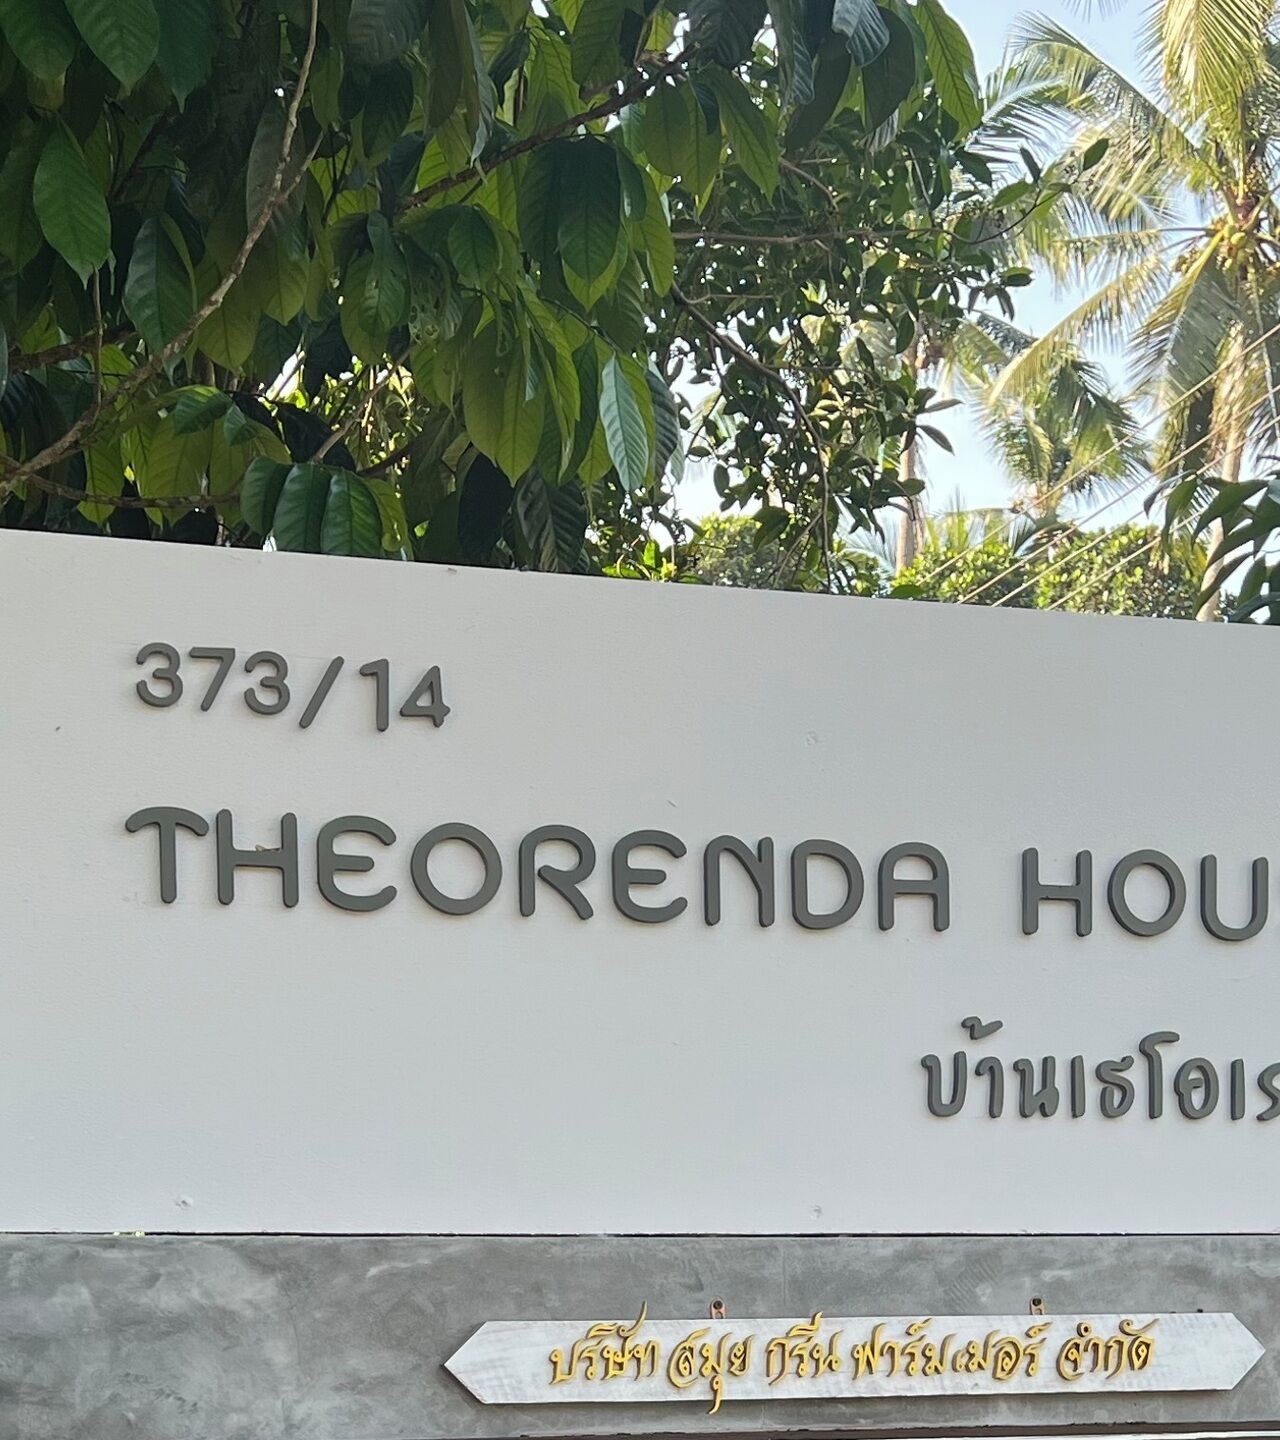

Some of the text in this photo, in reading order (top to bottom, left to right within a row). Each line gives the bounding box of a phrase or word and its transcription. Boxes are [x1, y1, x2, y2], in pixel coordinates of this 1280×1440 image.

[134, 641, 452, 734] 373/14
[123, 805, 952, 934] THEORENDA
[666, 1325, 756, 1415] สมุย
[765, 1311, 845, 1386] กรีน
[1055, 1317, 1161, 1383] จำกัด
